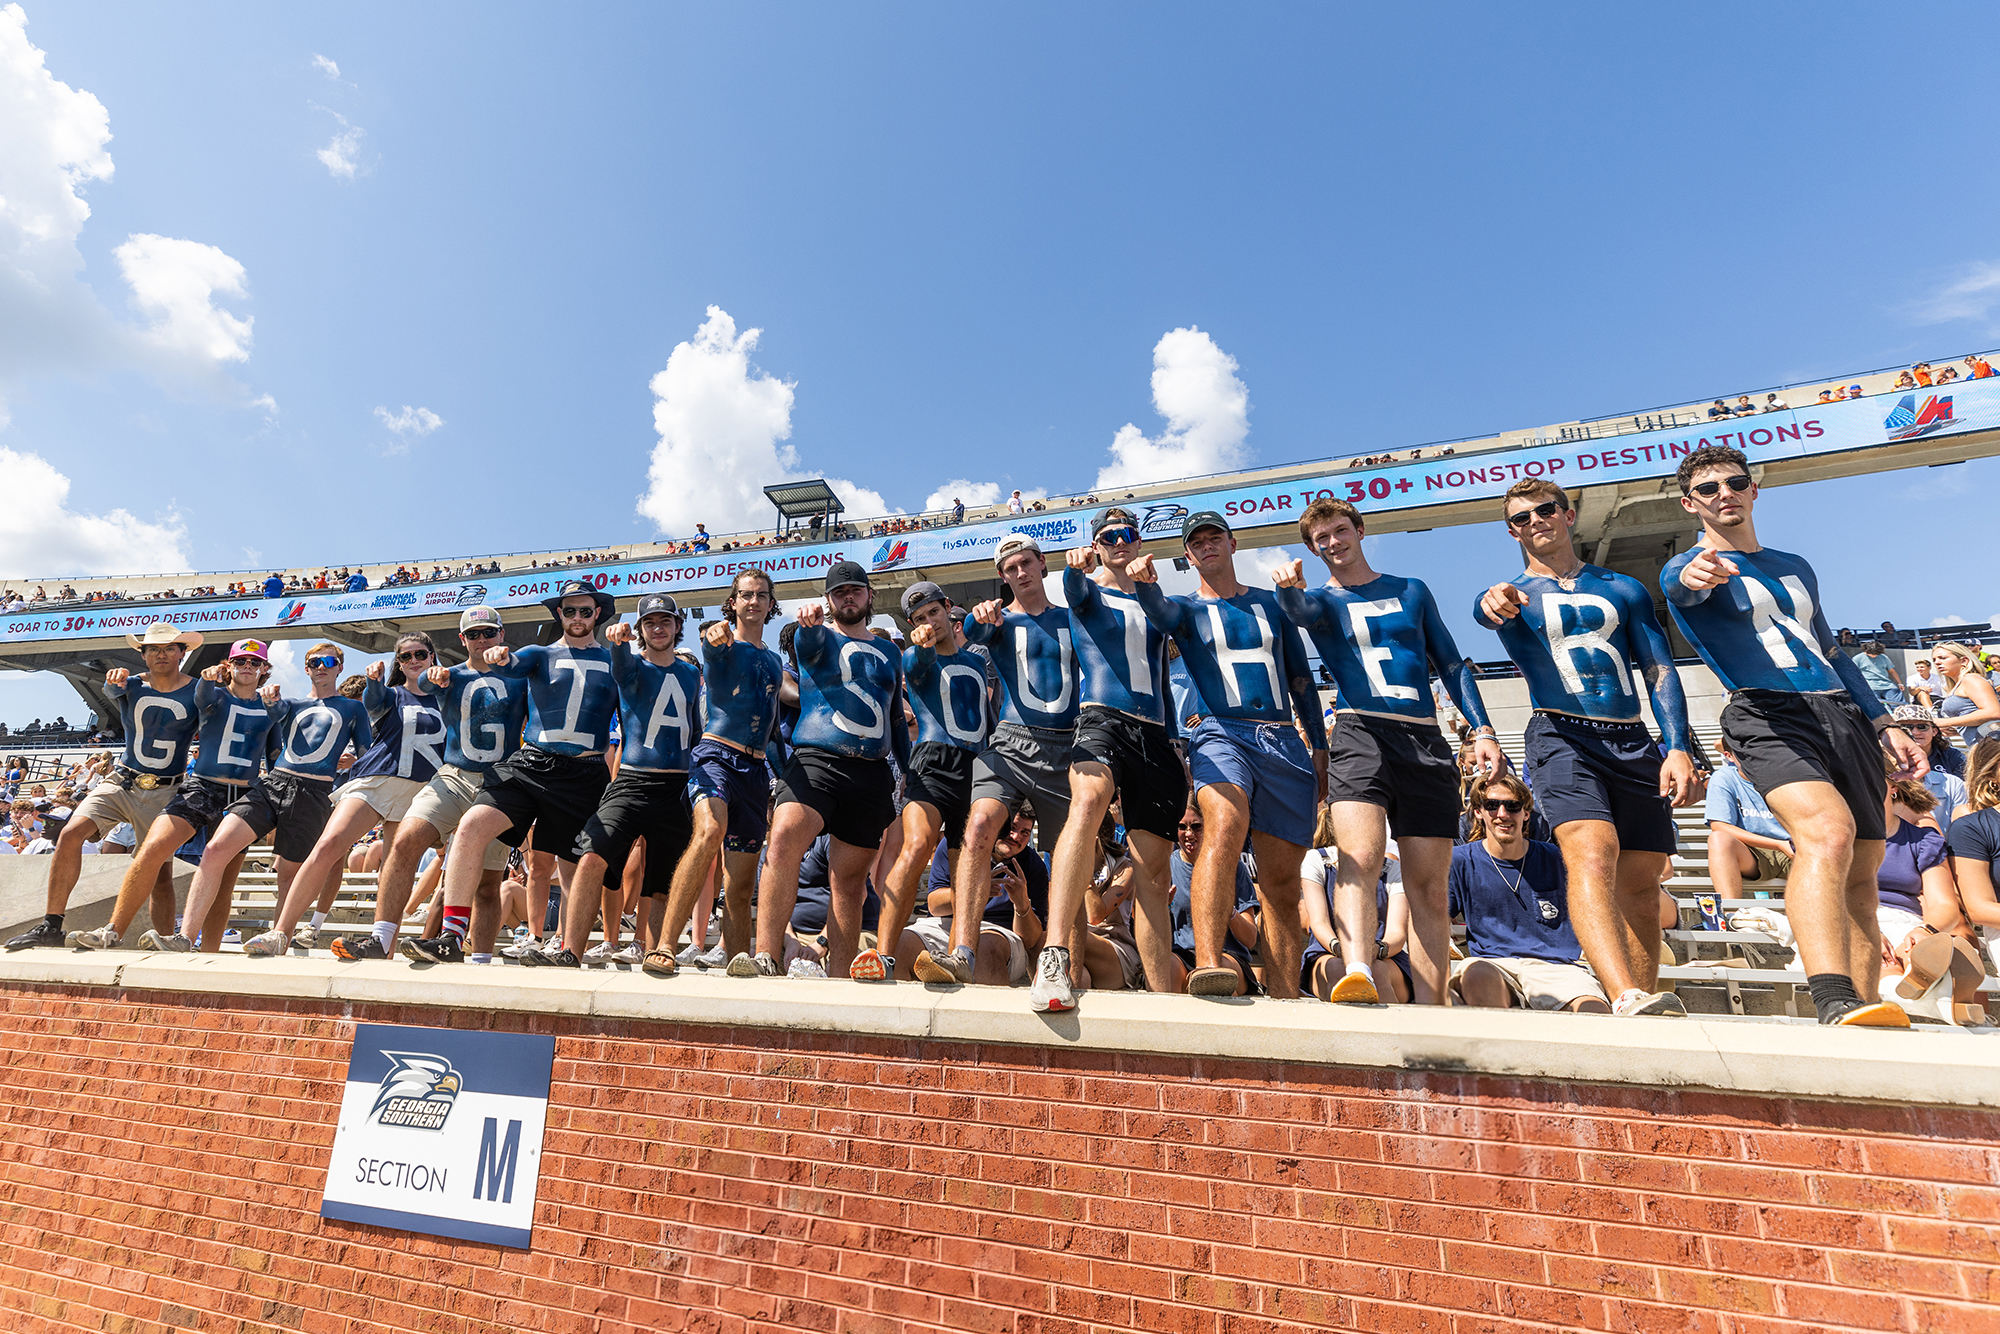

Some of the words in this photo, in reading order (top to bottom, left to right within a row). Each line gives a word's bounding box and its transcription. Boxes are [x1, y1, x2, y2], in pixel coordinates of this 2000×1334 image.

[1225, 495, 1292, 517] SOAR
[1344, 477, 1413, 502] 30+
[1425, 457, 1566, 491] NONSTOP
[1577, 420, 1825, 471] DESTINATIONS
[942, 536, 1002, 551] flySAV.com
[1011, 519, 1073, 535] SAVANNAH
[1047, 525, 1078, 537] HEAD
[370, 599, 395, 608] HILTON
[396, 597, 417, 606] HEAD
[375, 592, 416, 602] SAVANNAH
[424, 597, 456, 606] AIRPORT
[425, 590, 457, 599] OFFICIAL
[508, 582, 550, 597] SOAR
[555, 579, 573, 592] T
[627, 566, 708, 586] NONSTOP
[713, 552, 845, 577] DESTINATIONS
[7, 622, 41, 634] SOAR
[44, 620, 60, 631] TO
[62, 616, 95, 632] 30+
[98, 614, 160, 628] NONSTOP
[163, 608, 259, 624] DESTINATIONS
[328, 602, 368, 613] flySAV.com
[1015, 626, 1072, 714] U
[1207, 603, 1284, 711] H
[1346, 597, 1419, 701] E
[1541, 593, 1633, 696] R
[460, 676, 509, 763] G
[538, 658, 610, 749] I
[643, 673, 689, 750] A
[831, 641, 889, 739] S
[939, 664, 988, 743] O
[133, 695, 188, 769] G
[217, 704, 268, 767] E
[284, 706, 343, 764] O
[380, 1108, 445, 1130] SOUTHERN
[388, 1097, 451, 1117] GEORGIA
[355, 1157, 448, 1194] SECTION
[472, 1116, 523, 1204] M
